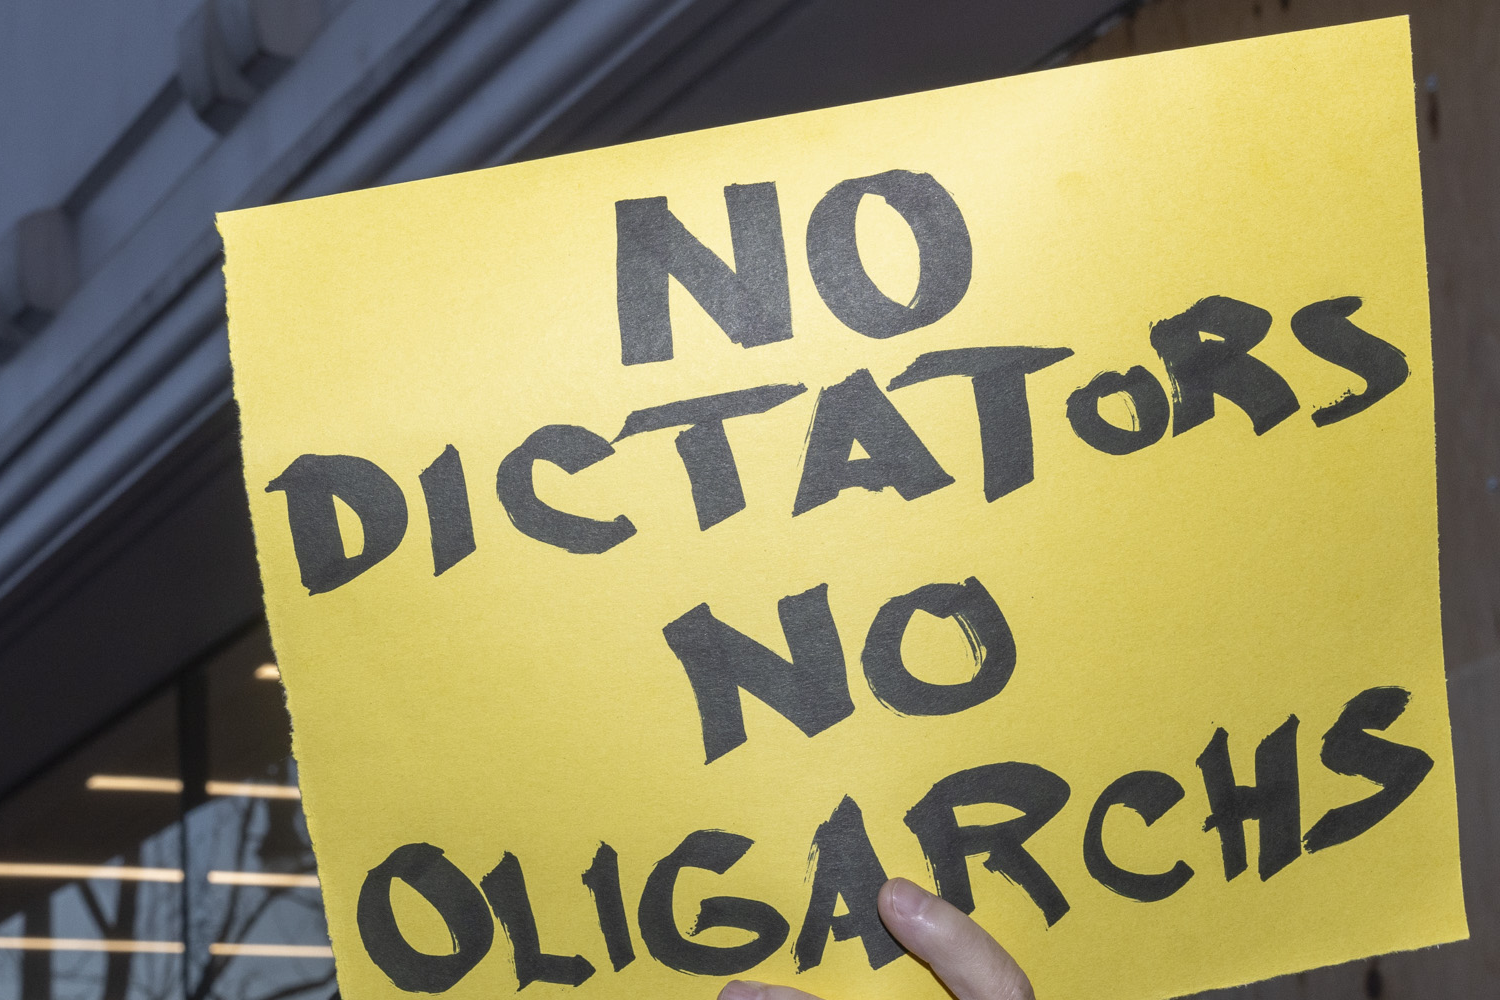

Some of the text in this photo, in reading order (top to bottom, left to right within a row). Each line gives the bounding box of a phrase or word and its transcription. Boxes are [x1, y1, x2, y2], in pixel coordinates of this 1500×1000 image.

[615, 170, 973, 367] NO
[662, 576, 1017, 766] NO
[357, 686, 1435, 995] OLIGARCHS
